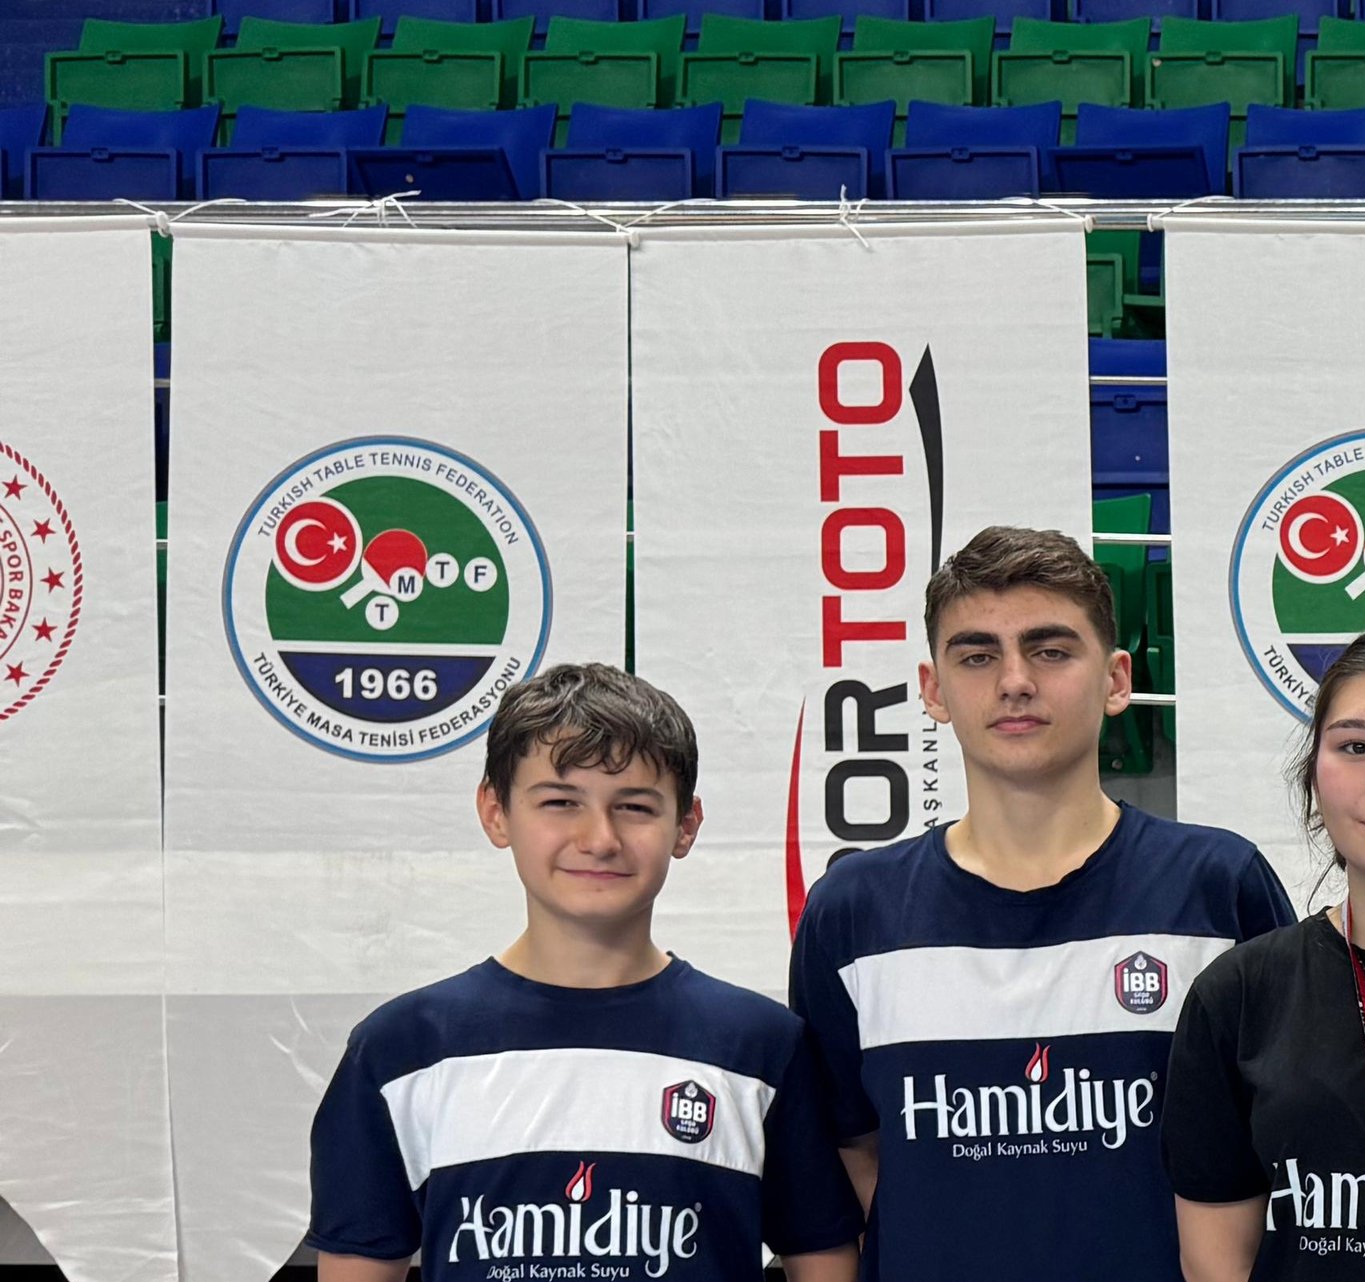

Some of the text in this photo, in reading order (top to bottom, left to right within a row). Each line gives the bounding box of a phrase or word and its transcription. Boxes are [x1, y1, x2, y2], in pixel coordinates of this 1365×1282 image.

[258, 452, 520, 546] TURKISH TABLE TENNIS FEDERATION
[818, 341, 906, 667] TOTO
[1262, 471, 1315, 534] TURKISH
[1314, 447, 1364, 478] TABLE
[1, 529, 24, 582] SPOR
[252, 652, 522, 748] TÜRKİYE MASA TENİSİ FEDERASYONU
[334, 667, 438, 701] 1966
[1264, 645, 1314, 707] TÜRKİYE
[824, 679, 909, 869] OR
[921, 711, 942, 831] AŞKANL
[900, 1068, 1155, 1150] Hamidiye
[952, 1138, 1088, 1161] Doğal Kaynak Suyu
[448, 1188, 700, 1278] Hamidiye
[530, 1262, 586, 1282] Kaynak
[591, 1263, 630, 1282] Suyu
[1299, 1236, 1341, 1256] Doğal
